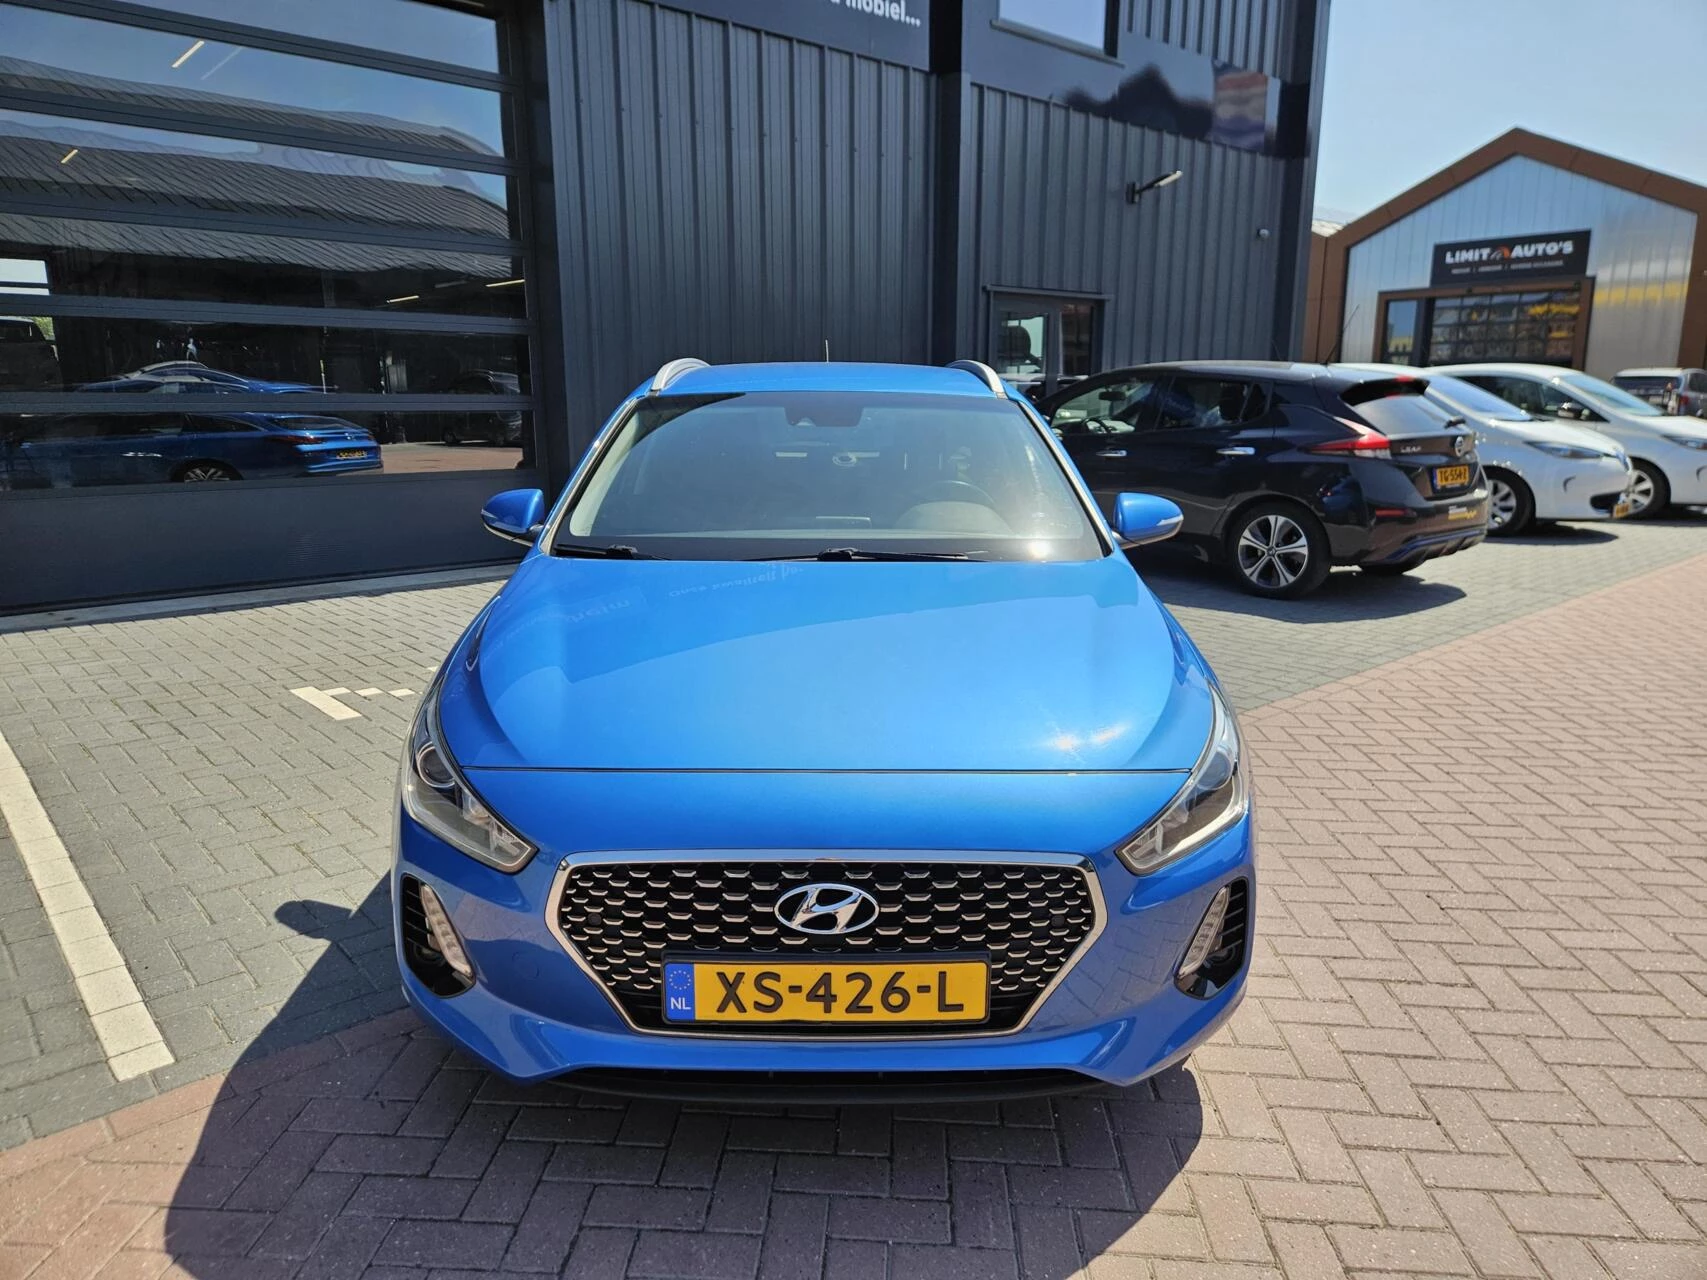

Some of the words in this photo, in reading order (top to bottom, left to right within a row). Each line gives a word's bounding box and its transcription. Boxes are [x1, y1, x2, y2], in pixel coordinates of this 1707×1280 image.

[1445, 247, 1492, 264] LIMIT
[1510, 240, 1574, 259] AUTO'S
[670, 997, 691, 1010] NL
[716, 971, 964, 1014] XS-426-L
